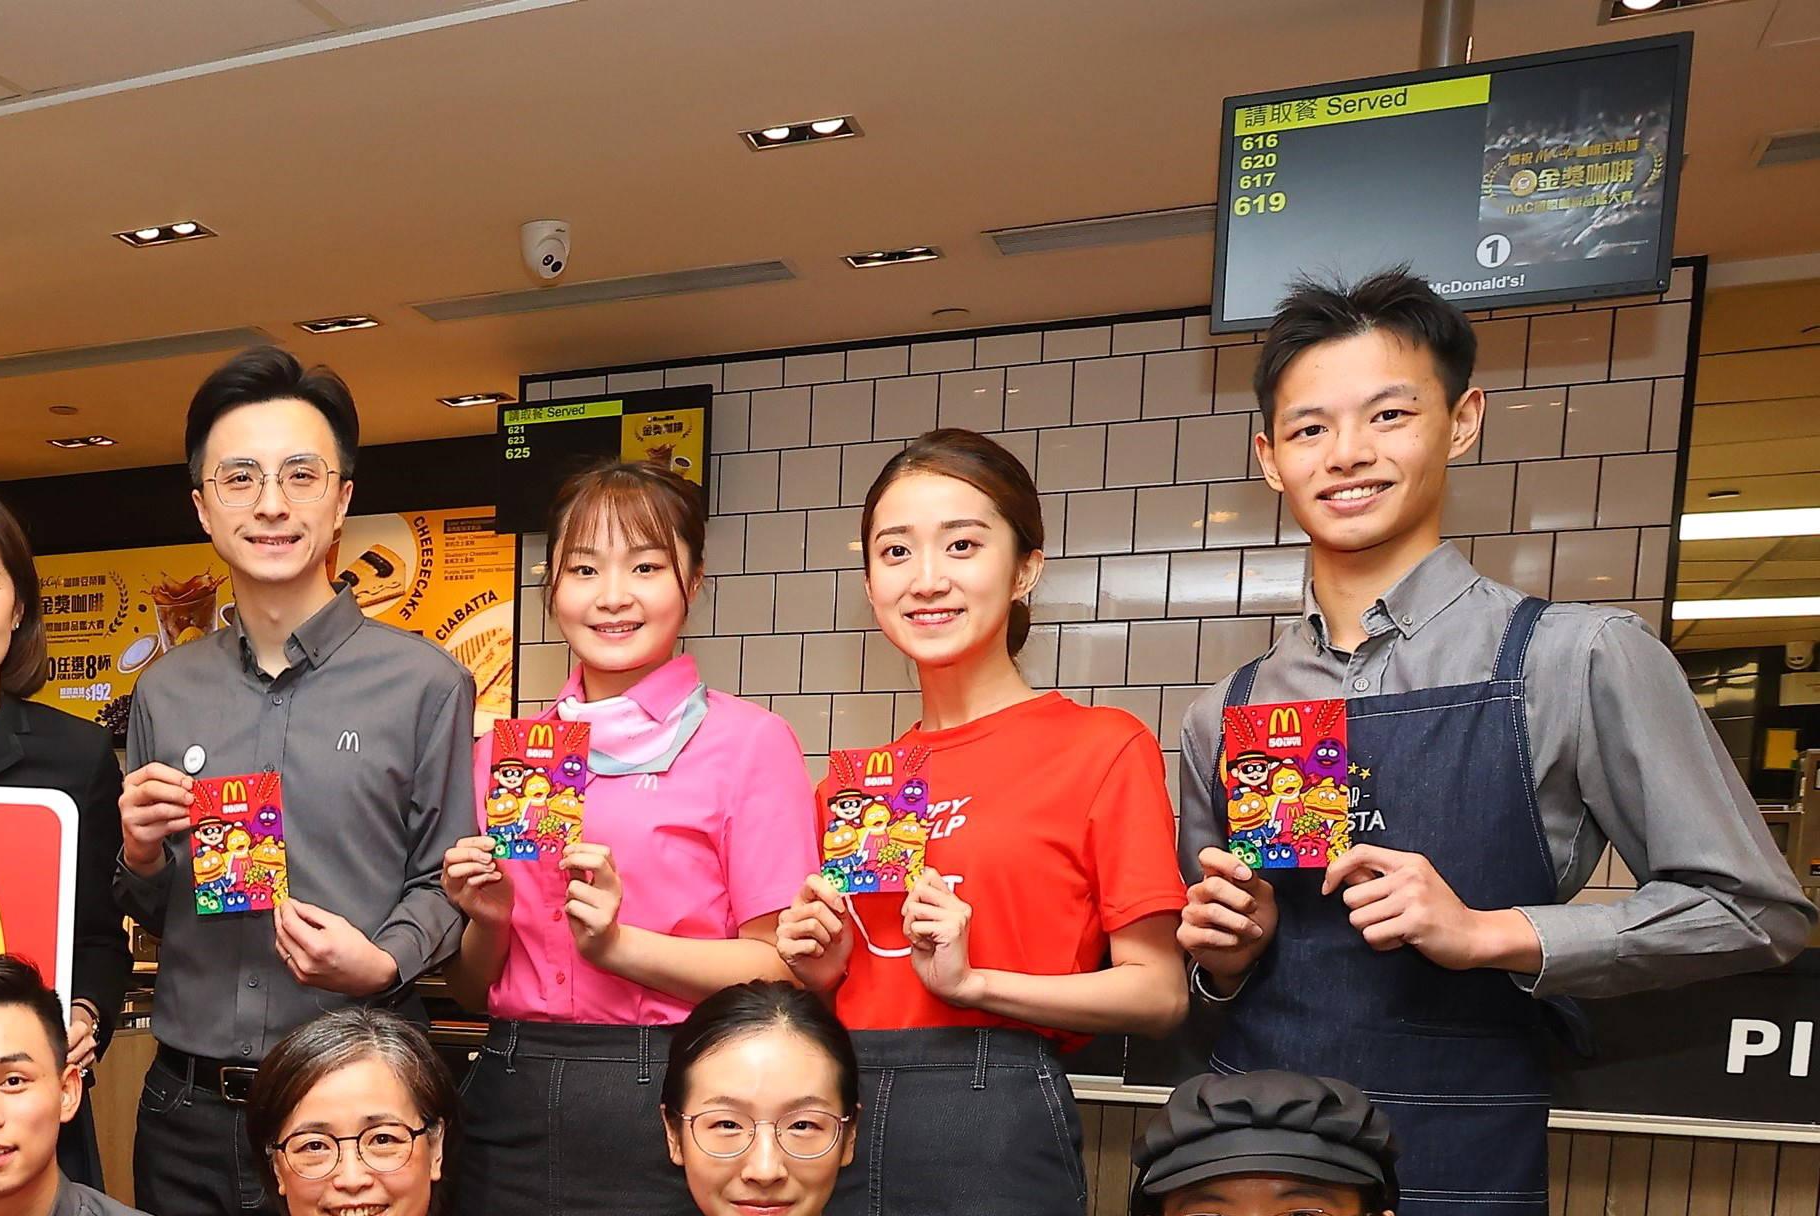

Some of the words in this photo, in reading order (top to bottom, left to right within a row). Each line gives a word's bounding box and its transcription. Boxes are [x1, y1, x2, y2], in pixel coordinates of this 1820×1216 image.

[1244, 98, 1318, 128] 請取餐
[1326, 88, 1408, 116] Served
[1242, 134, 1279, 151] 616
[1240, 153, 1277, 170] 620
[1239, 172, 1276, 190] 617
[1537, 160, 1636, 192] 金獎咖啡
[1233, 192, 1287, 216] 619
[547, 405, 585, 417] Served
[508, 426, 524, 434] 621
[507, 436, 525, 445] 623
[505, 447, 530, 459] 625
[399, 516, 433, 620] CHEESECAKE
[435, 589, 498, 640] CIABATTA
[85, 683, 111, 700] $192
